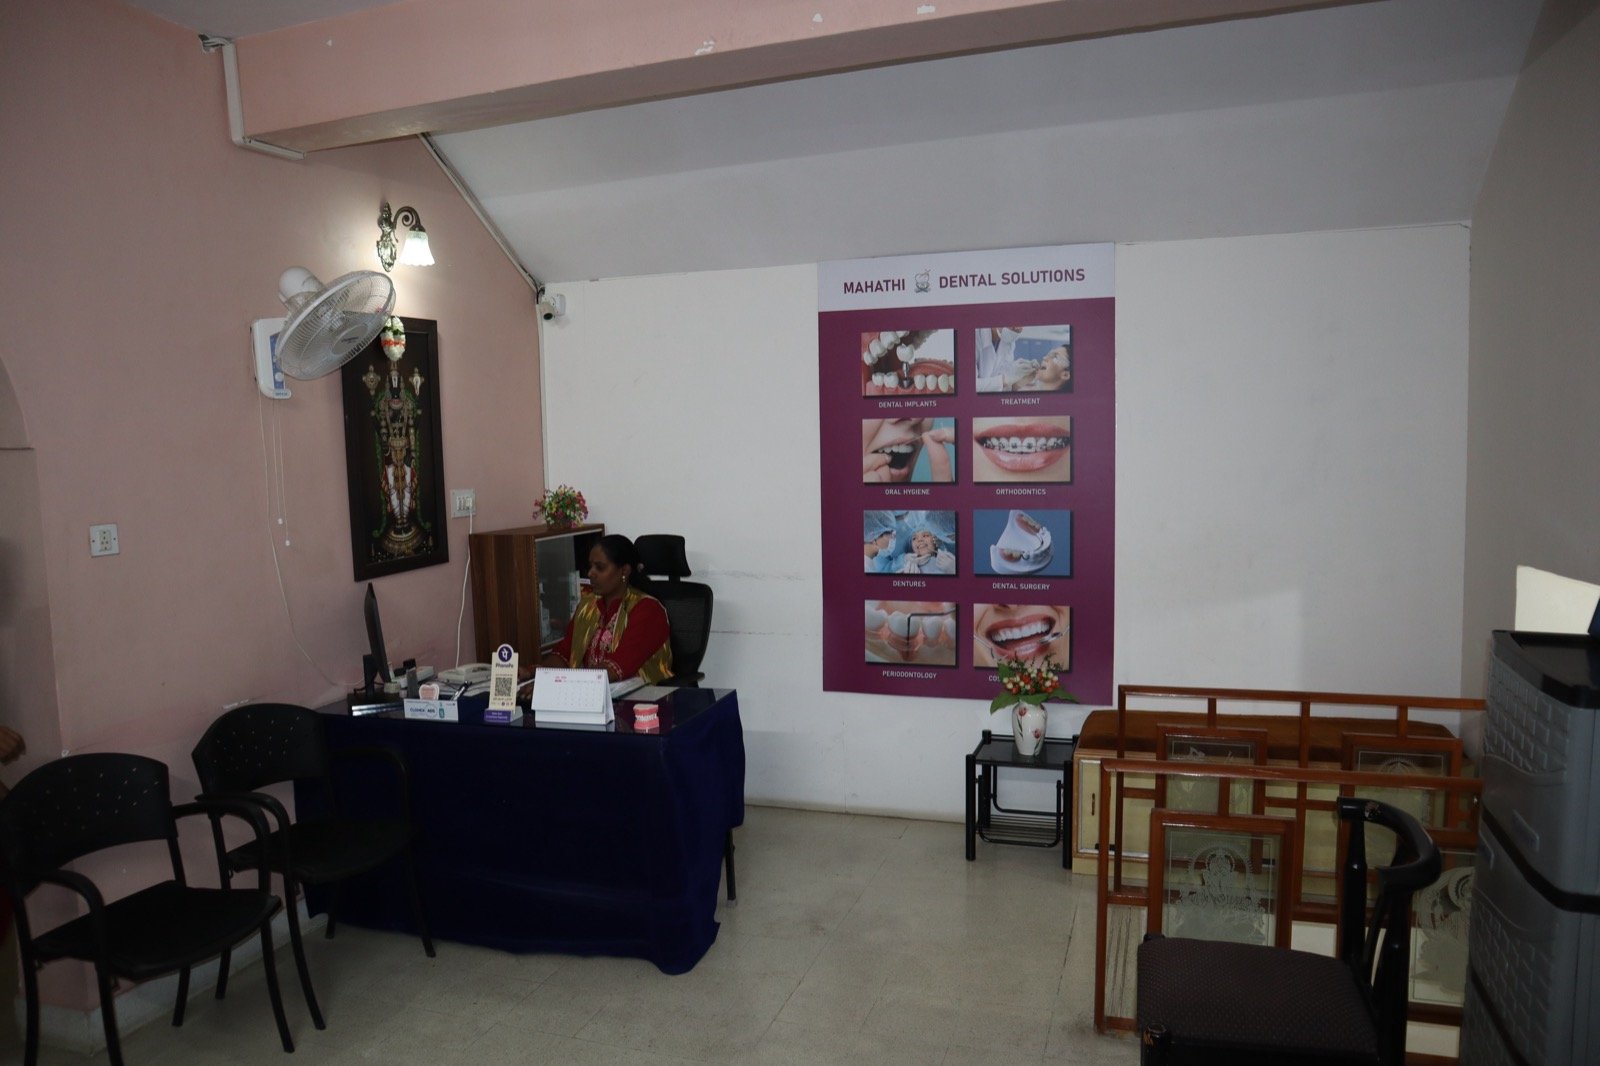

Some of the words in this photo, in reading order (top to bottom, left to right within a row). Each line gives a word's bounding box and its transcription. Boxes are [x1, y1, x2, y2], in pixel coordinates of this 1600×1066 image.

[843, 278, 906, 294] MAHATHI
[939, 273, 997, 289] DENTAL
[1001, 268, 1086, 285] SOLUTIONS
[904, 400, 937, 408] IMPLANTS
[1001, 398, 1040, 406] TREATMENT
[885, 488, 901, 496] ORAL
[903, 488, 930, 496] HYGIENE
[996, 488, 1047, 496] ORTHODONTICS
[892, 580, 926, 588] DENTURES
[992, 582, 1018, 590] DENTAL
[1019, 583, 1050, 591] SURGERY
[882, 670, 937, 679] PERIODONTOLOGY
